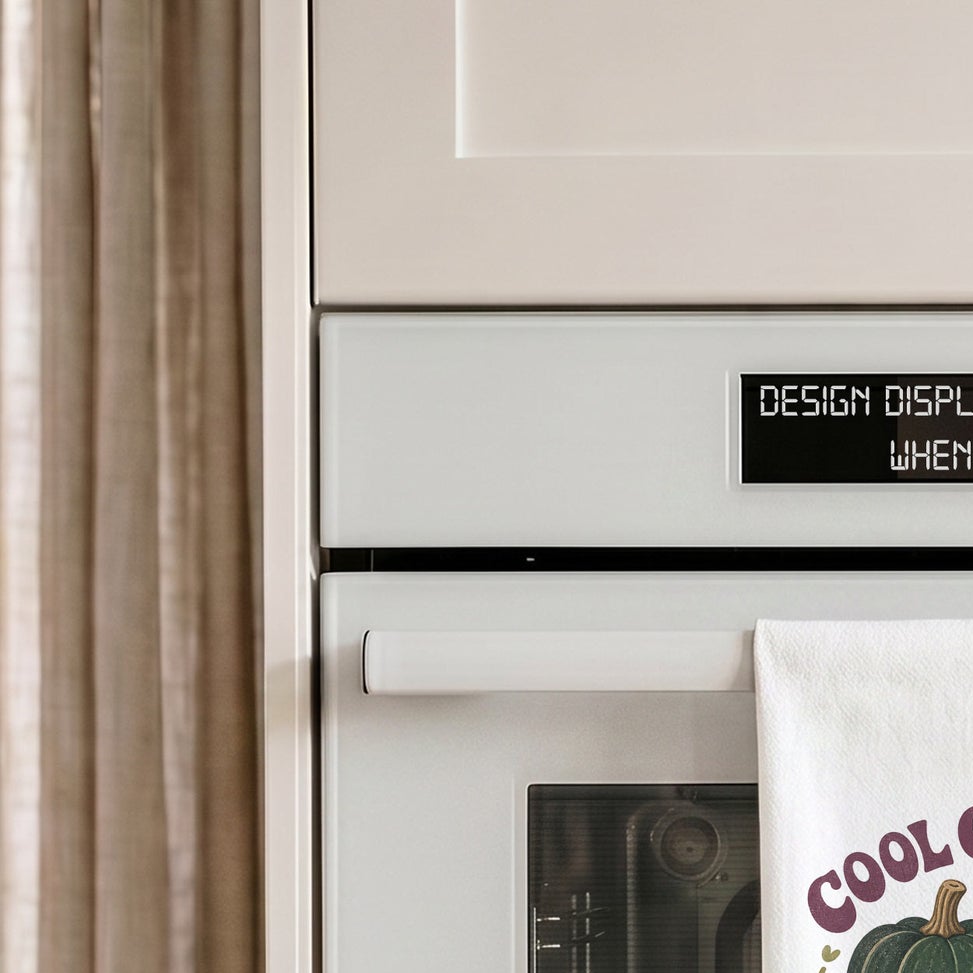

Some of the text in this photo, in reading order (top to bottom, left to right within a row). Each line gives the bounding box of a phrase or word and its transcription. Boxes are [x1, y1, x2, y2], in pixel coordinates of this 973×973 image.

[760, 385, 870, 417] DESIGN
[890, 439, 972, 471] WHEN
[807, 820, 954, 933] COOL
